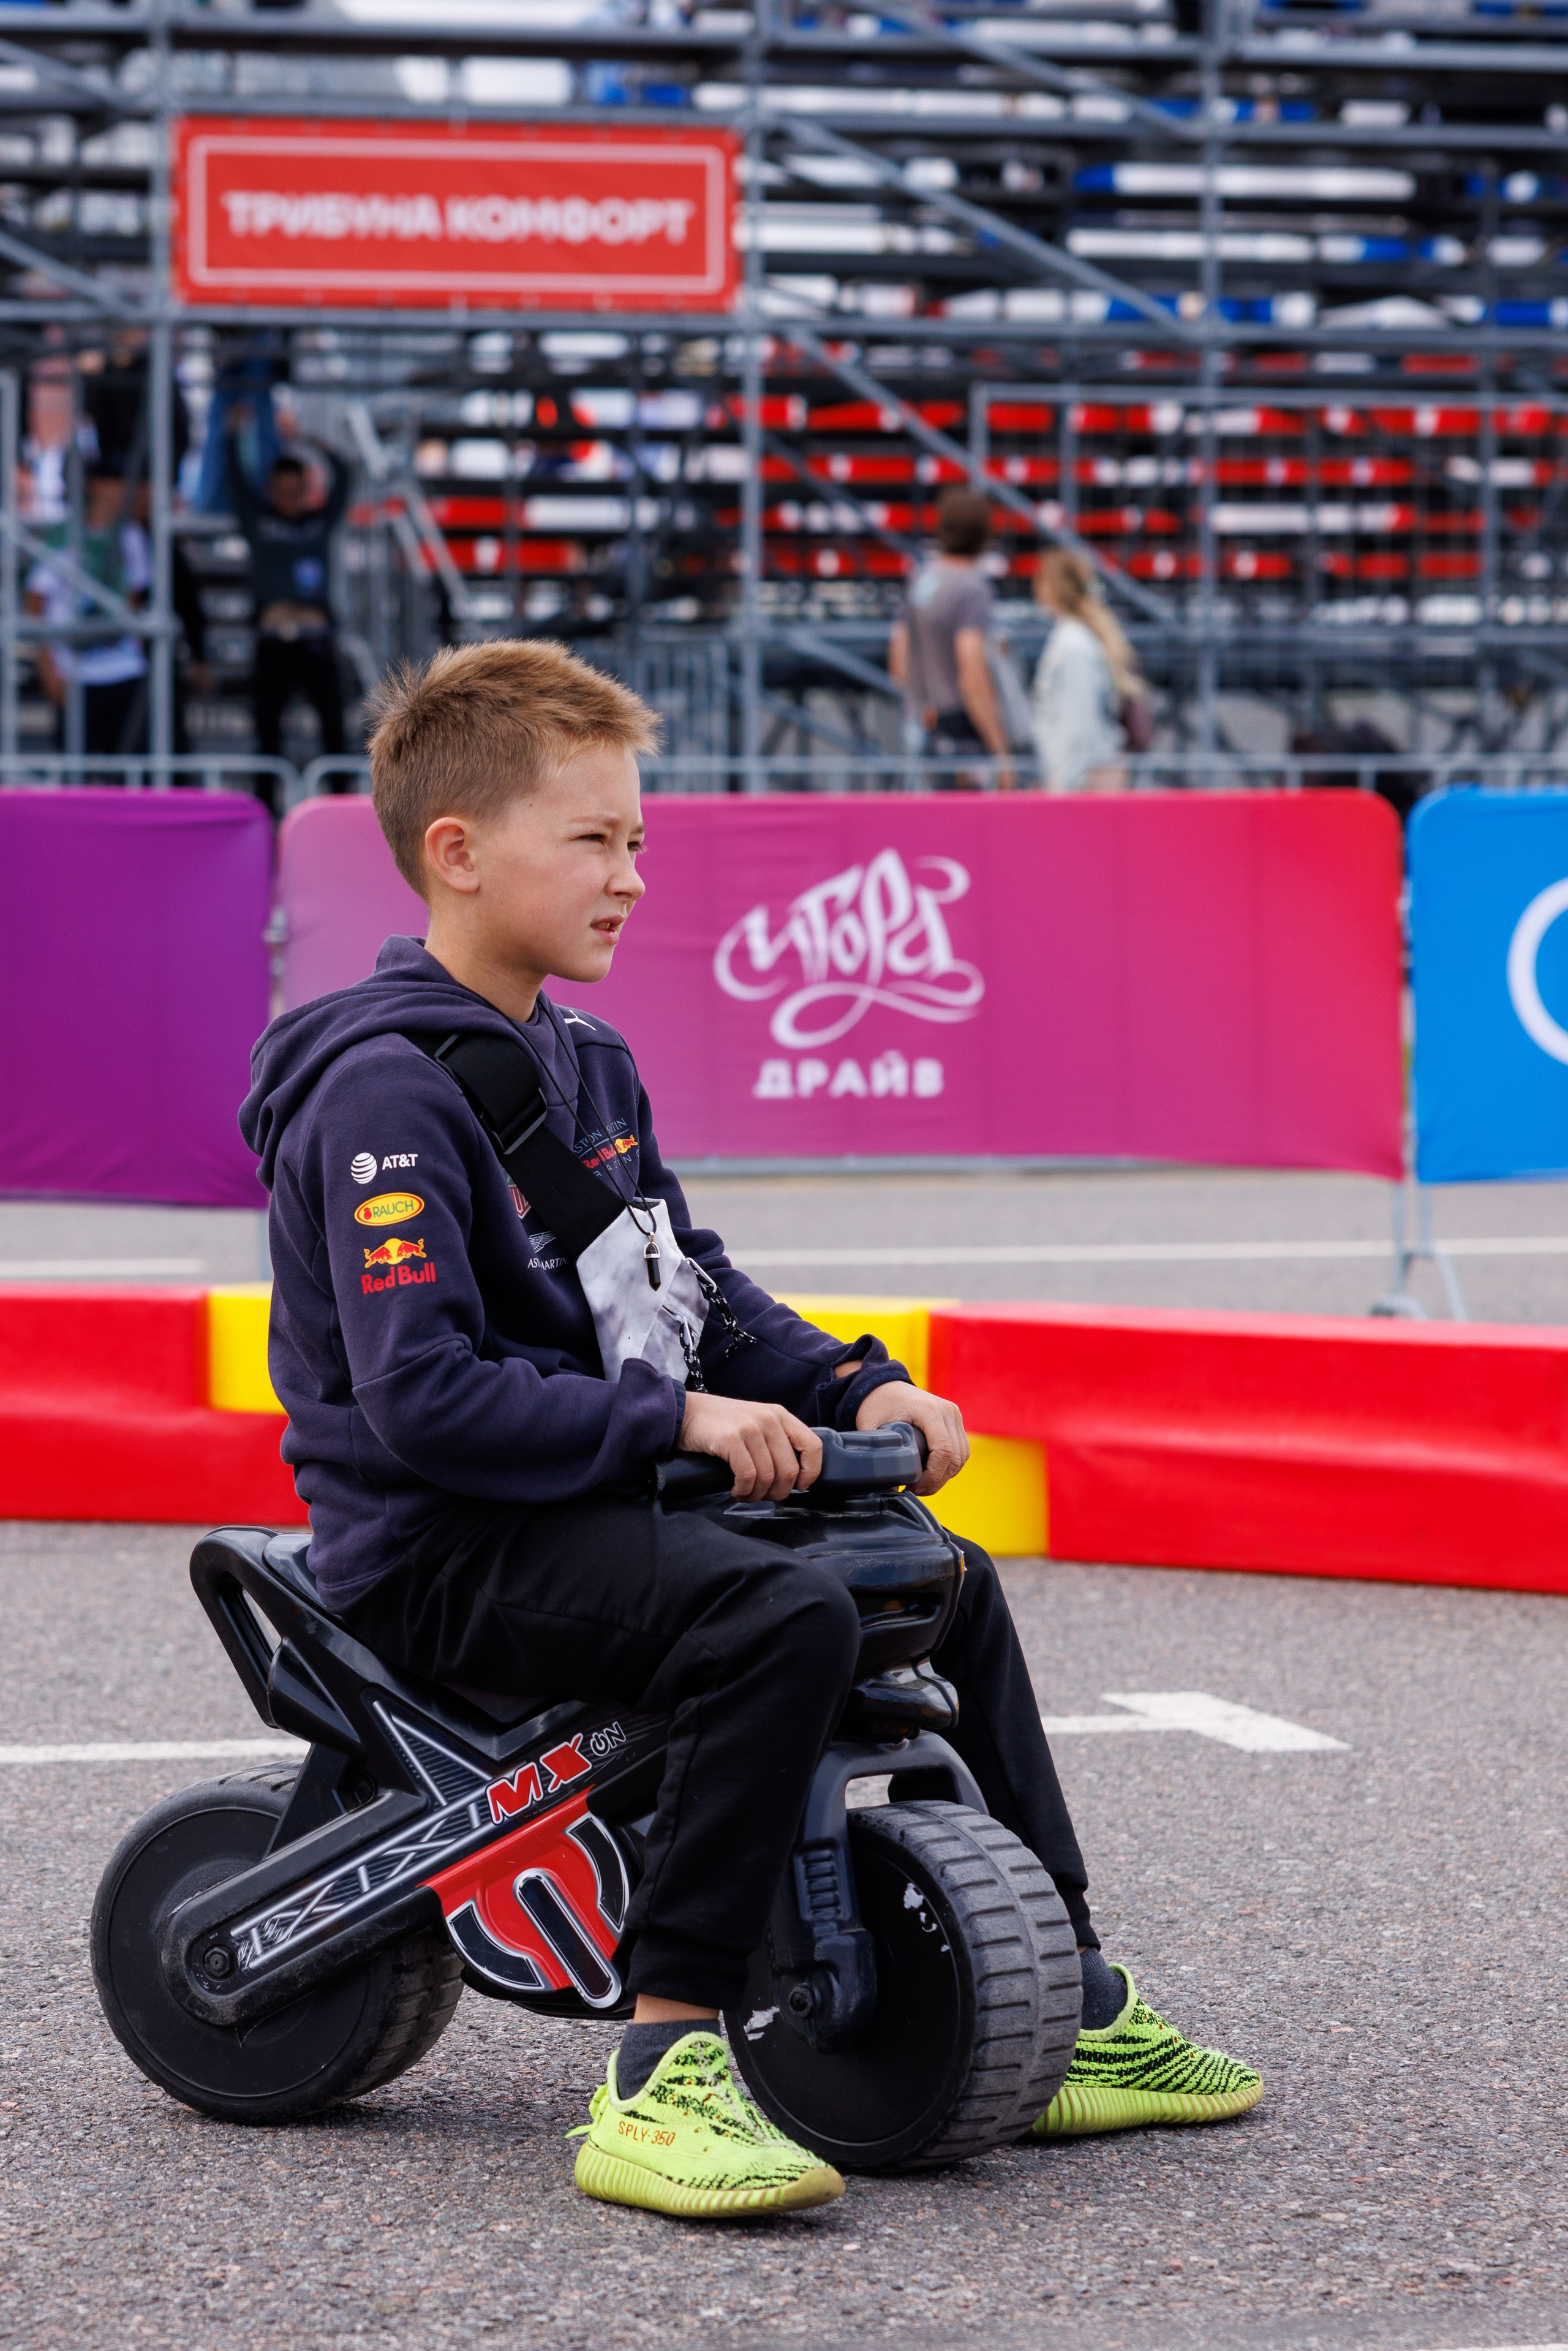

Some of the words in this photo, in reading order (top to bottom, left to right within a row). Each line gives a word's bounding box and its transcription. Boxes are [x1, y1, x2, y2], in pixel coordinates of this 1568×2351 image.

[445, 193, 696, 246] КОМФОРТ
[752, 1050, 944, 1099] ДРАЙВ
[382, 1153, 418, 1170] AT&T
[373, 1199, 414, 1218] RAUCH
[361, 1267, 396, 1294] Red
[398, 1262, 436, 1285] Bull
[486, 1733, 592, 1824] MX
[590, 1721, 626, 1756] ON
[618, 2121, 676, 2146] SPLY-350
